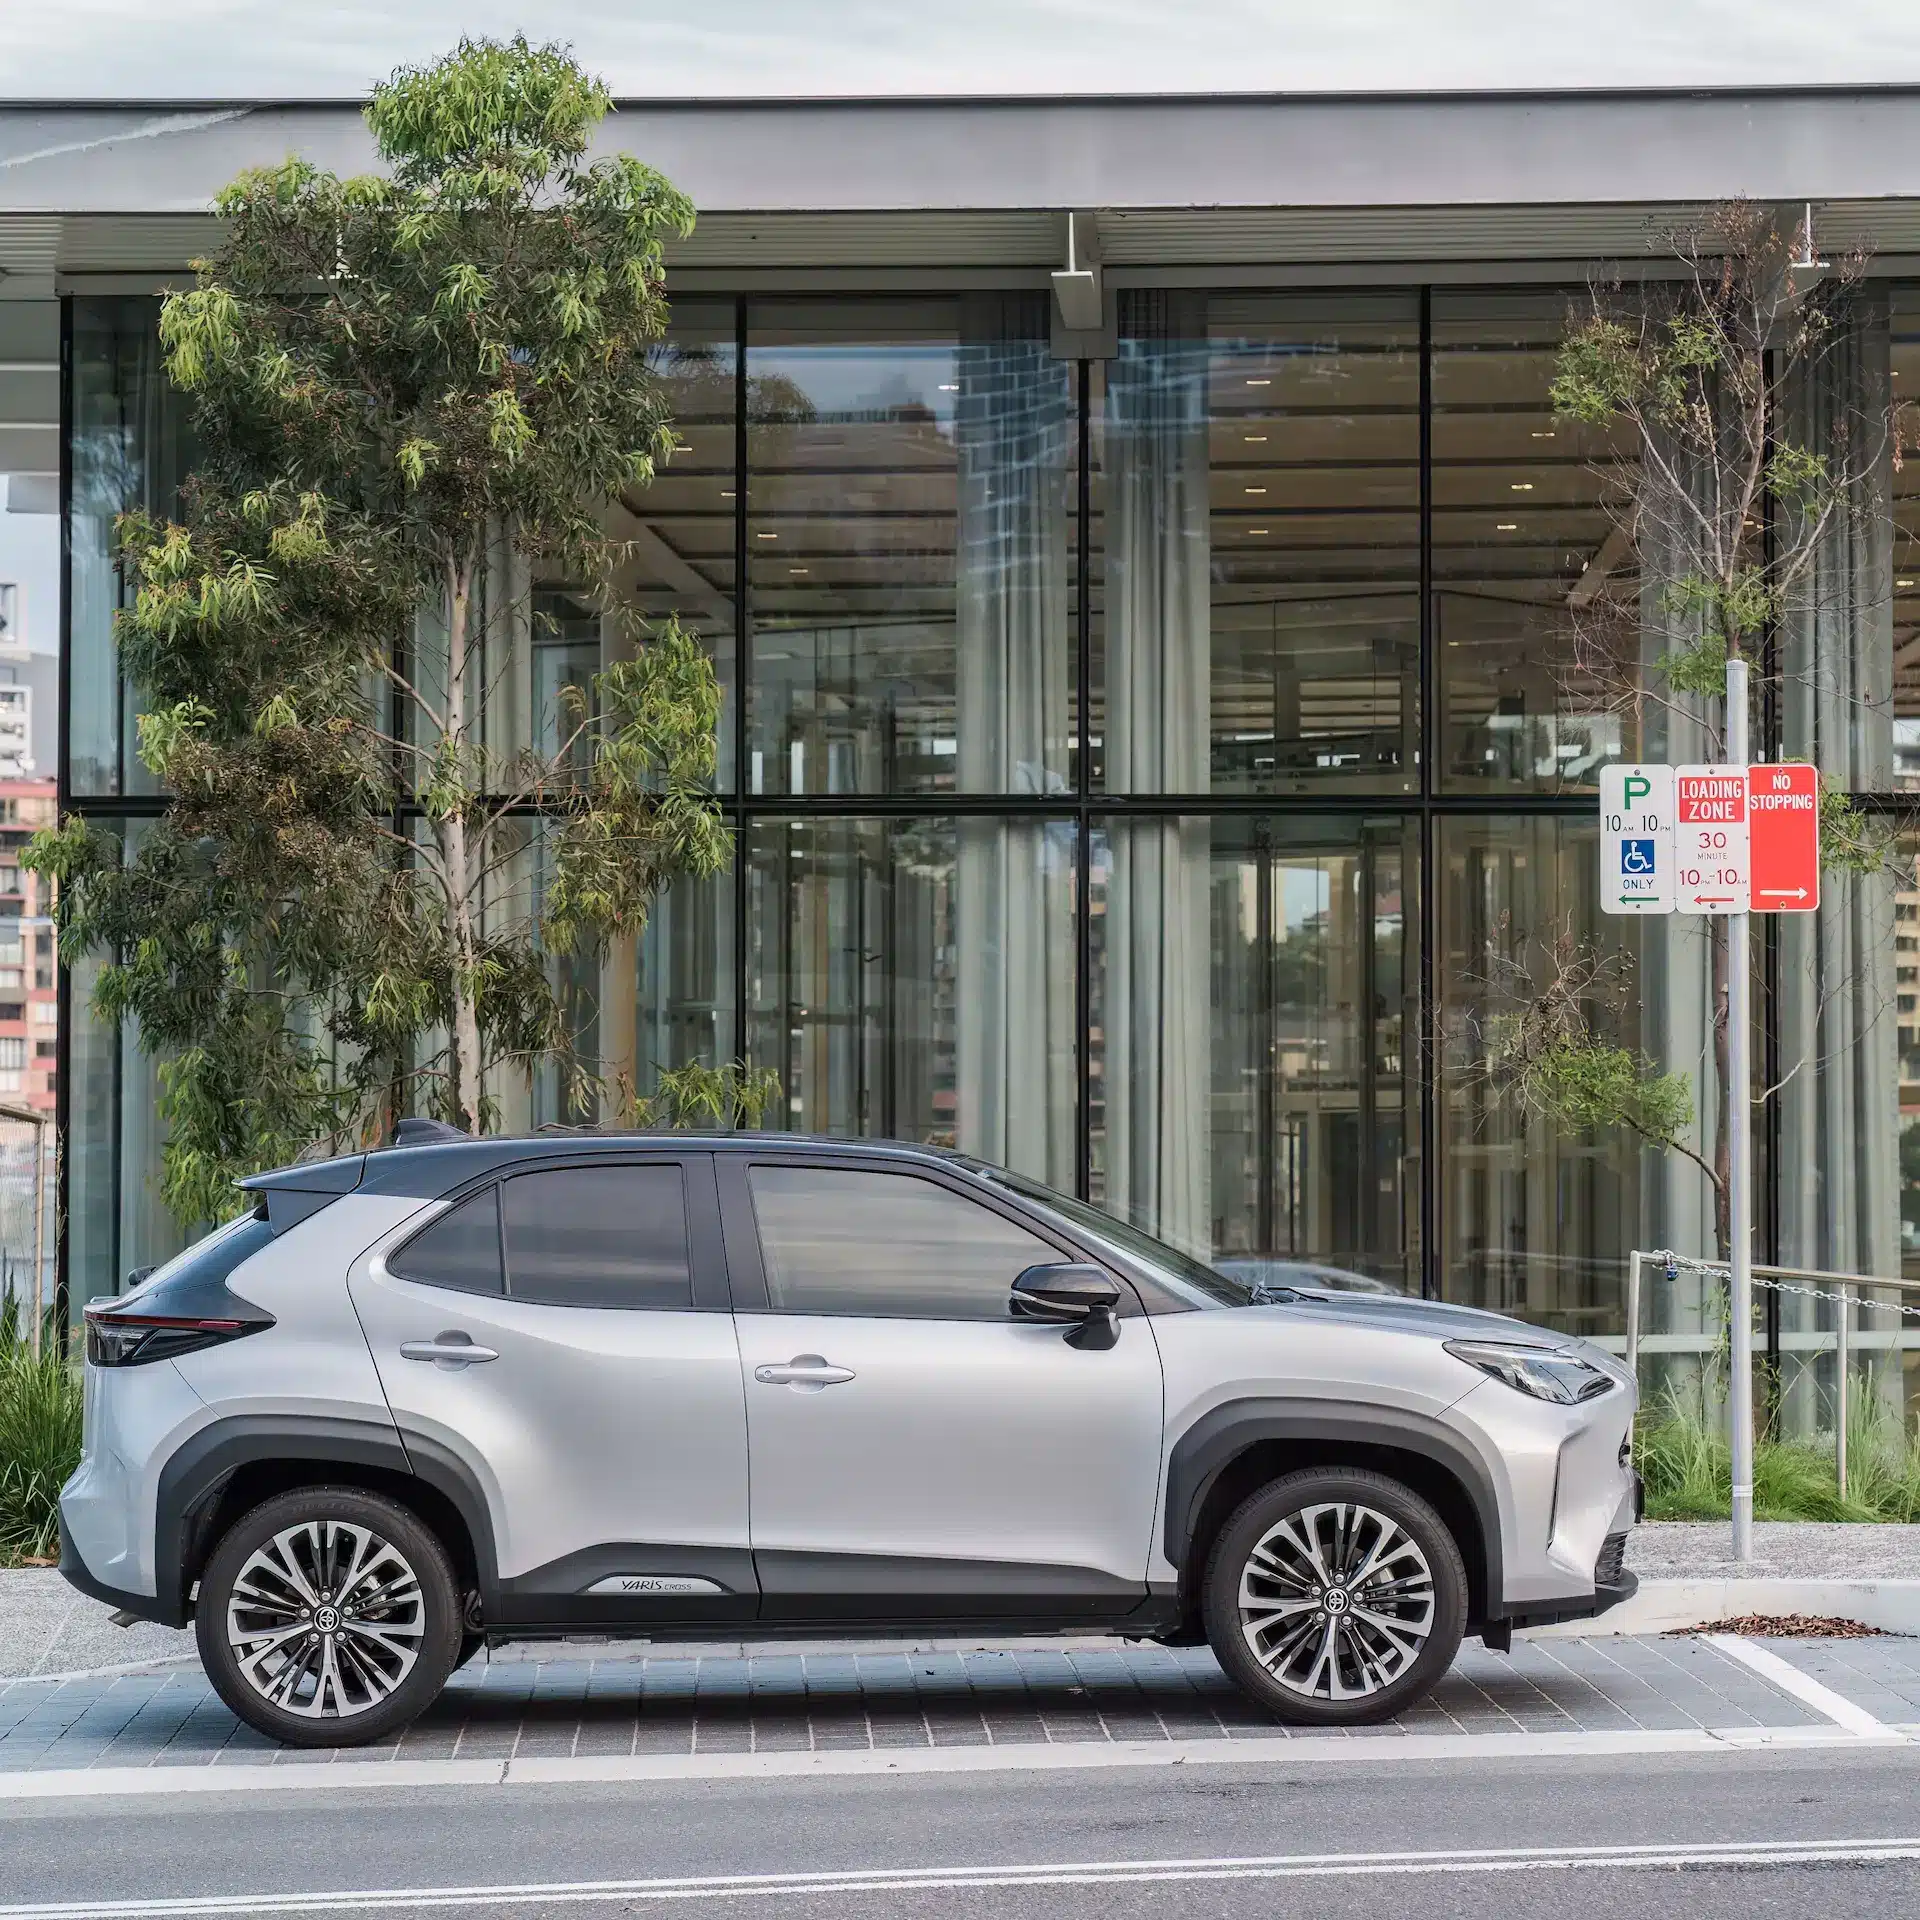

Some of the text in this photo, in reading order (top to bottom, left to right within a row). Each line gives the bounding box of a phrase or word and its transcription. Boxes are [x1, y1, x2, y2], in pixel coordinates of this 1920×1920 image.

[1681, 780, 1742, 799] LOADING
[1772, 775, 1791, 790] NO
[1624, 776, 1651, 810] P
[1750, 794, 1813, 810] STOPPING
[1688, 801, 1736, 820] ZONE
[1698, 832, 1727, 849] 30
[1697, 852, 1728, 860] MINUTE
[1623, 879, 1654, 890] ONLY
[621, 1579, 663, 1590] YARIS
